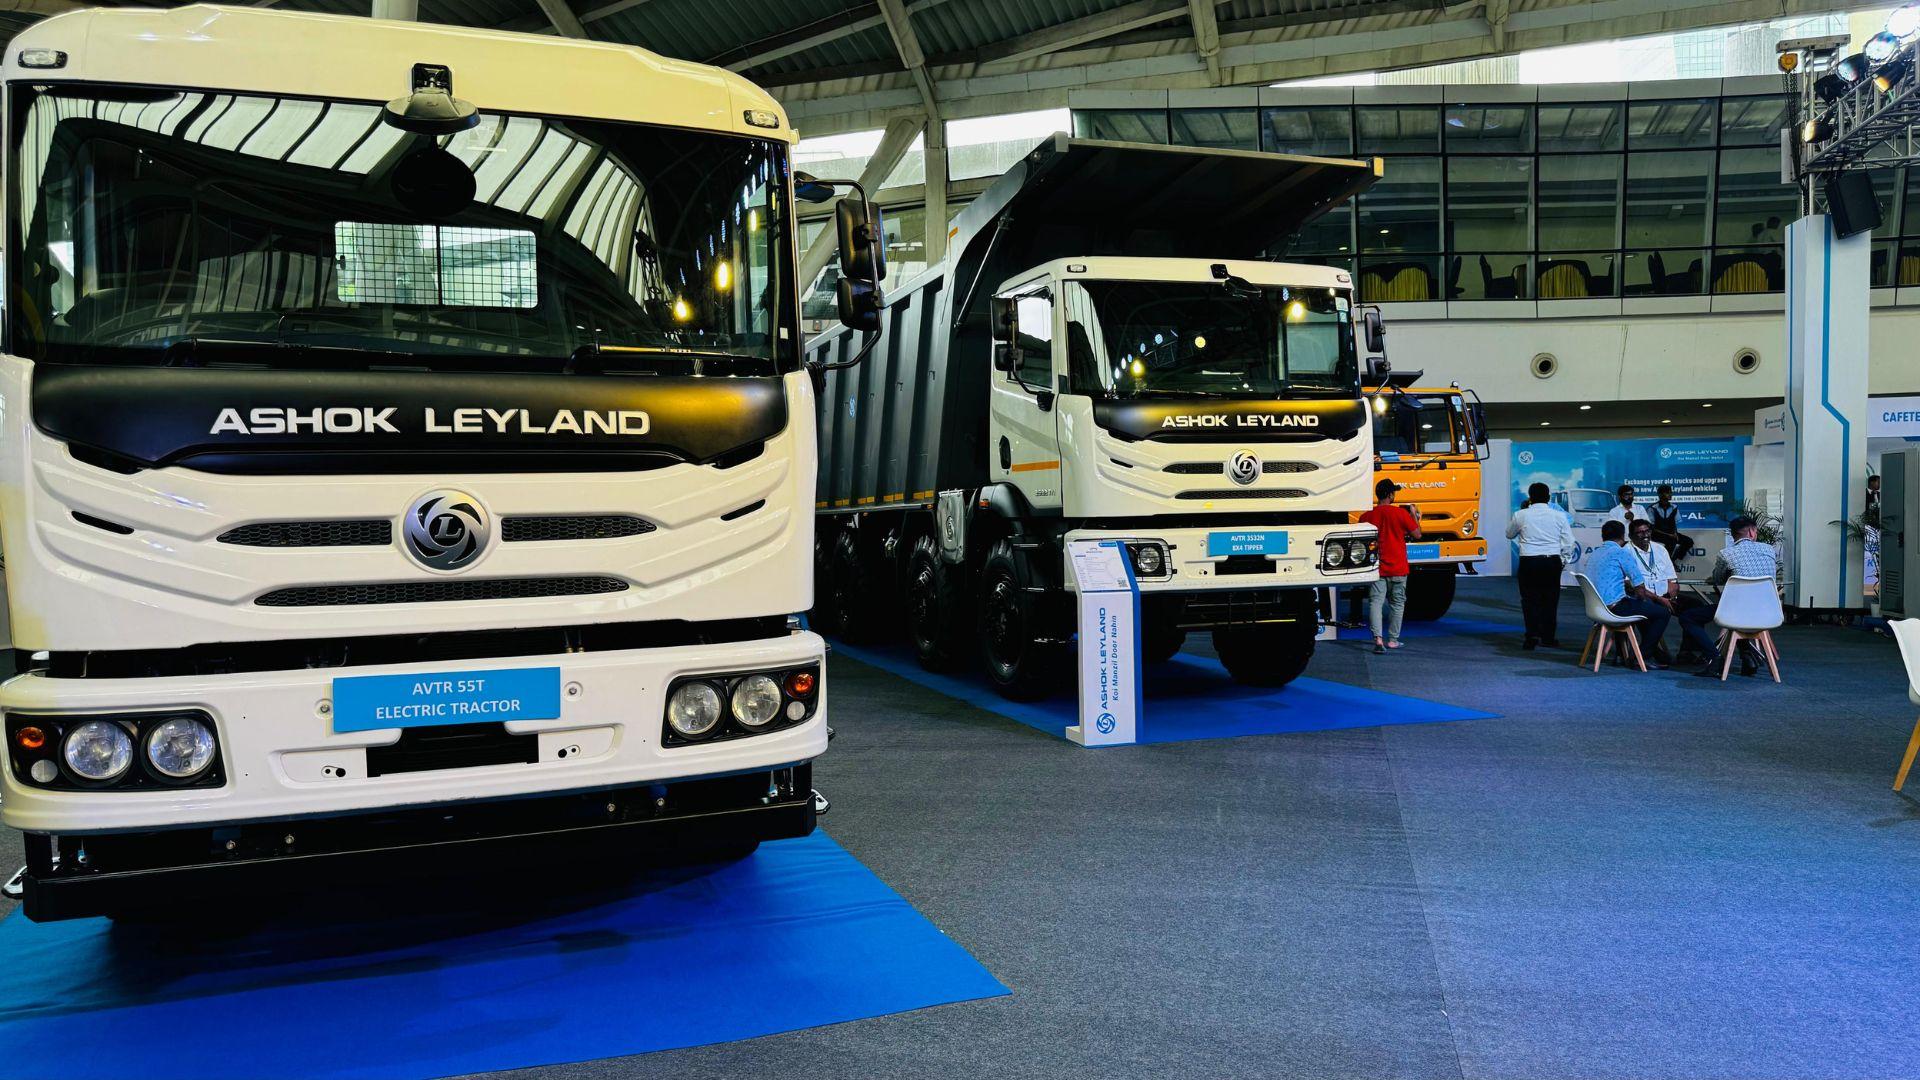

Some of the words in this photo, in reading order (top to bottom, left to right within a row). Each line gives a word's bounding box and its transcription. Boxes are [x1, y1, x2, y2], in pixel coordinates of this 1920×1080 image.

[209, 407, 400, 436] ASHOK
[425, 407, 651, 436] LEYLAND
[1162, 415, 1229, 428] ASHOK
[1237, 414, 1319, 427] LEYLAND
[1409, 481, 1447, 489] LEYLAND
[1624, 478, 1651, 486] Exchange
[1664, 477, 1673, 485] old
[1674, 477, 1692, 485] trucks
[1693, 476, 1704, 484] and
[1704, 476, 1728, 485] upgrade
[1671, 485, 1693, 494] Leyland
[1693, 484, 1718, 492] vehicles
[1099, 607, 1107, 664] LEYLAND
[412, 681, 453, 696] AVTR
[458, 679, 486, 693] 55T
[1100, 666, 1108, 710] ASHOK
[375, 703, 446, 720] ELECTRIC
[450, 699, 521, 716] TRACTOR
